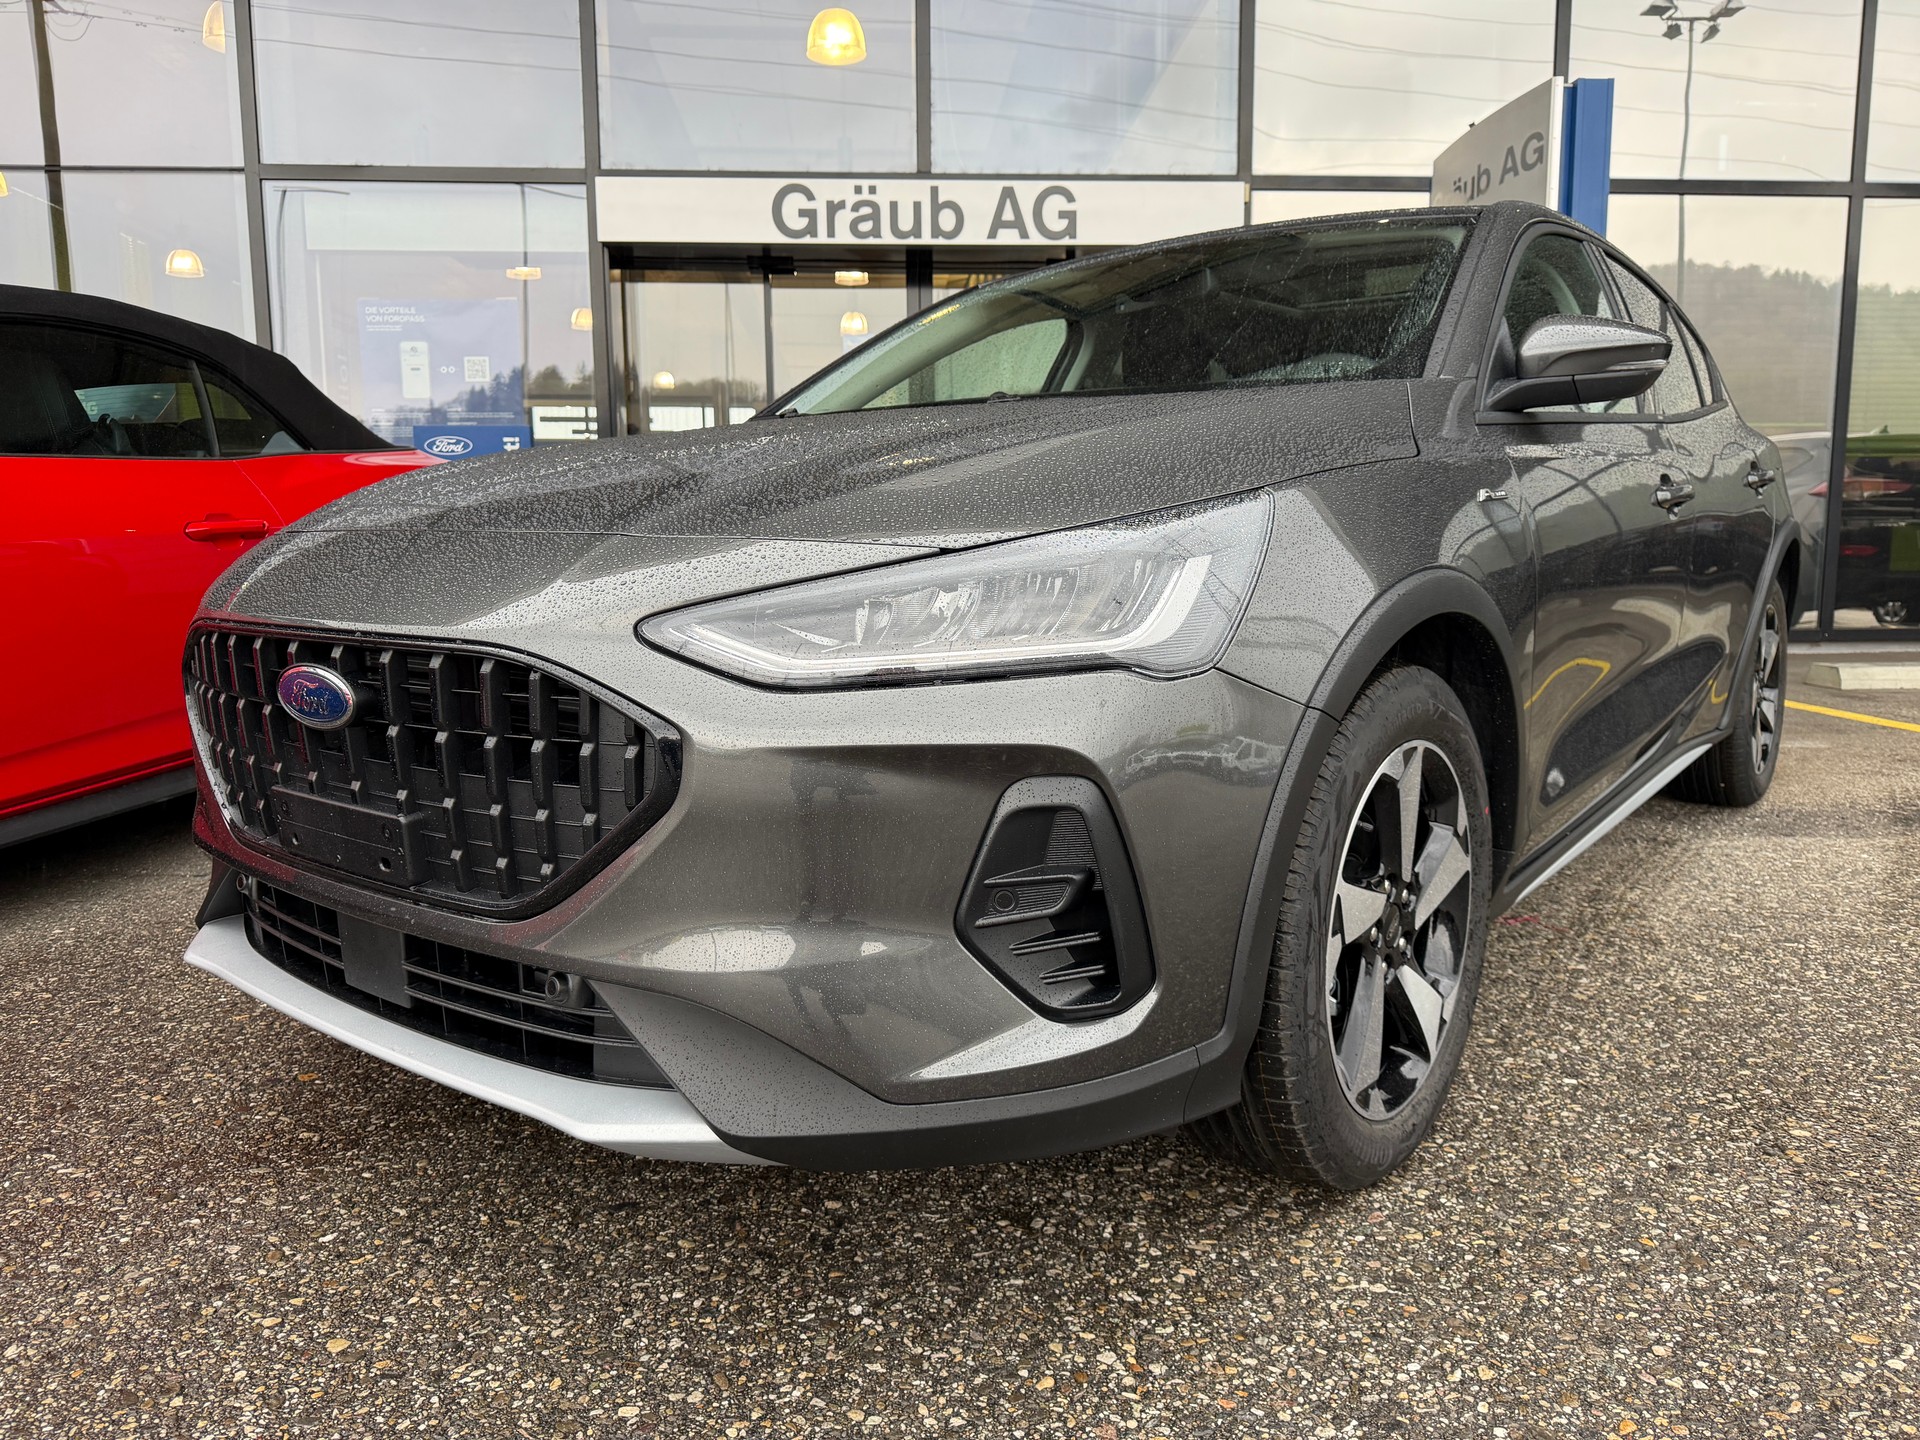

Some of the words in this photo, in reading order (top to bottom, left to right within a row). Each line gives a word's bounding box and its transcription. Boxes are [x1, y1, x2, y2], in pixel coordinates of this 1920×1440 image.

[1498, 131, 1545, 186] AG
[771, 183, 965, 240] Gräub
[987, 185, 1077, 241] AG
[365, 306, 378, 315] DIE
[379, 306, 416, 315] VORTEILE
[366, 315, 383, 324] VON
[431, 438, 466, 454] Ford
